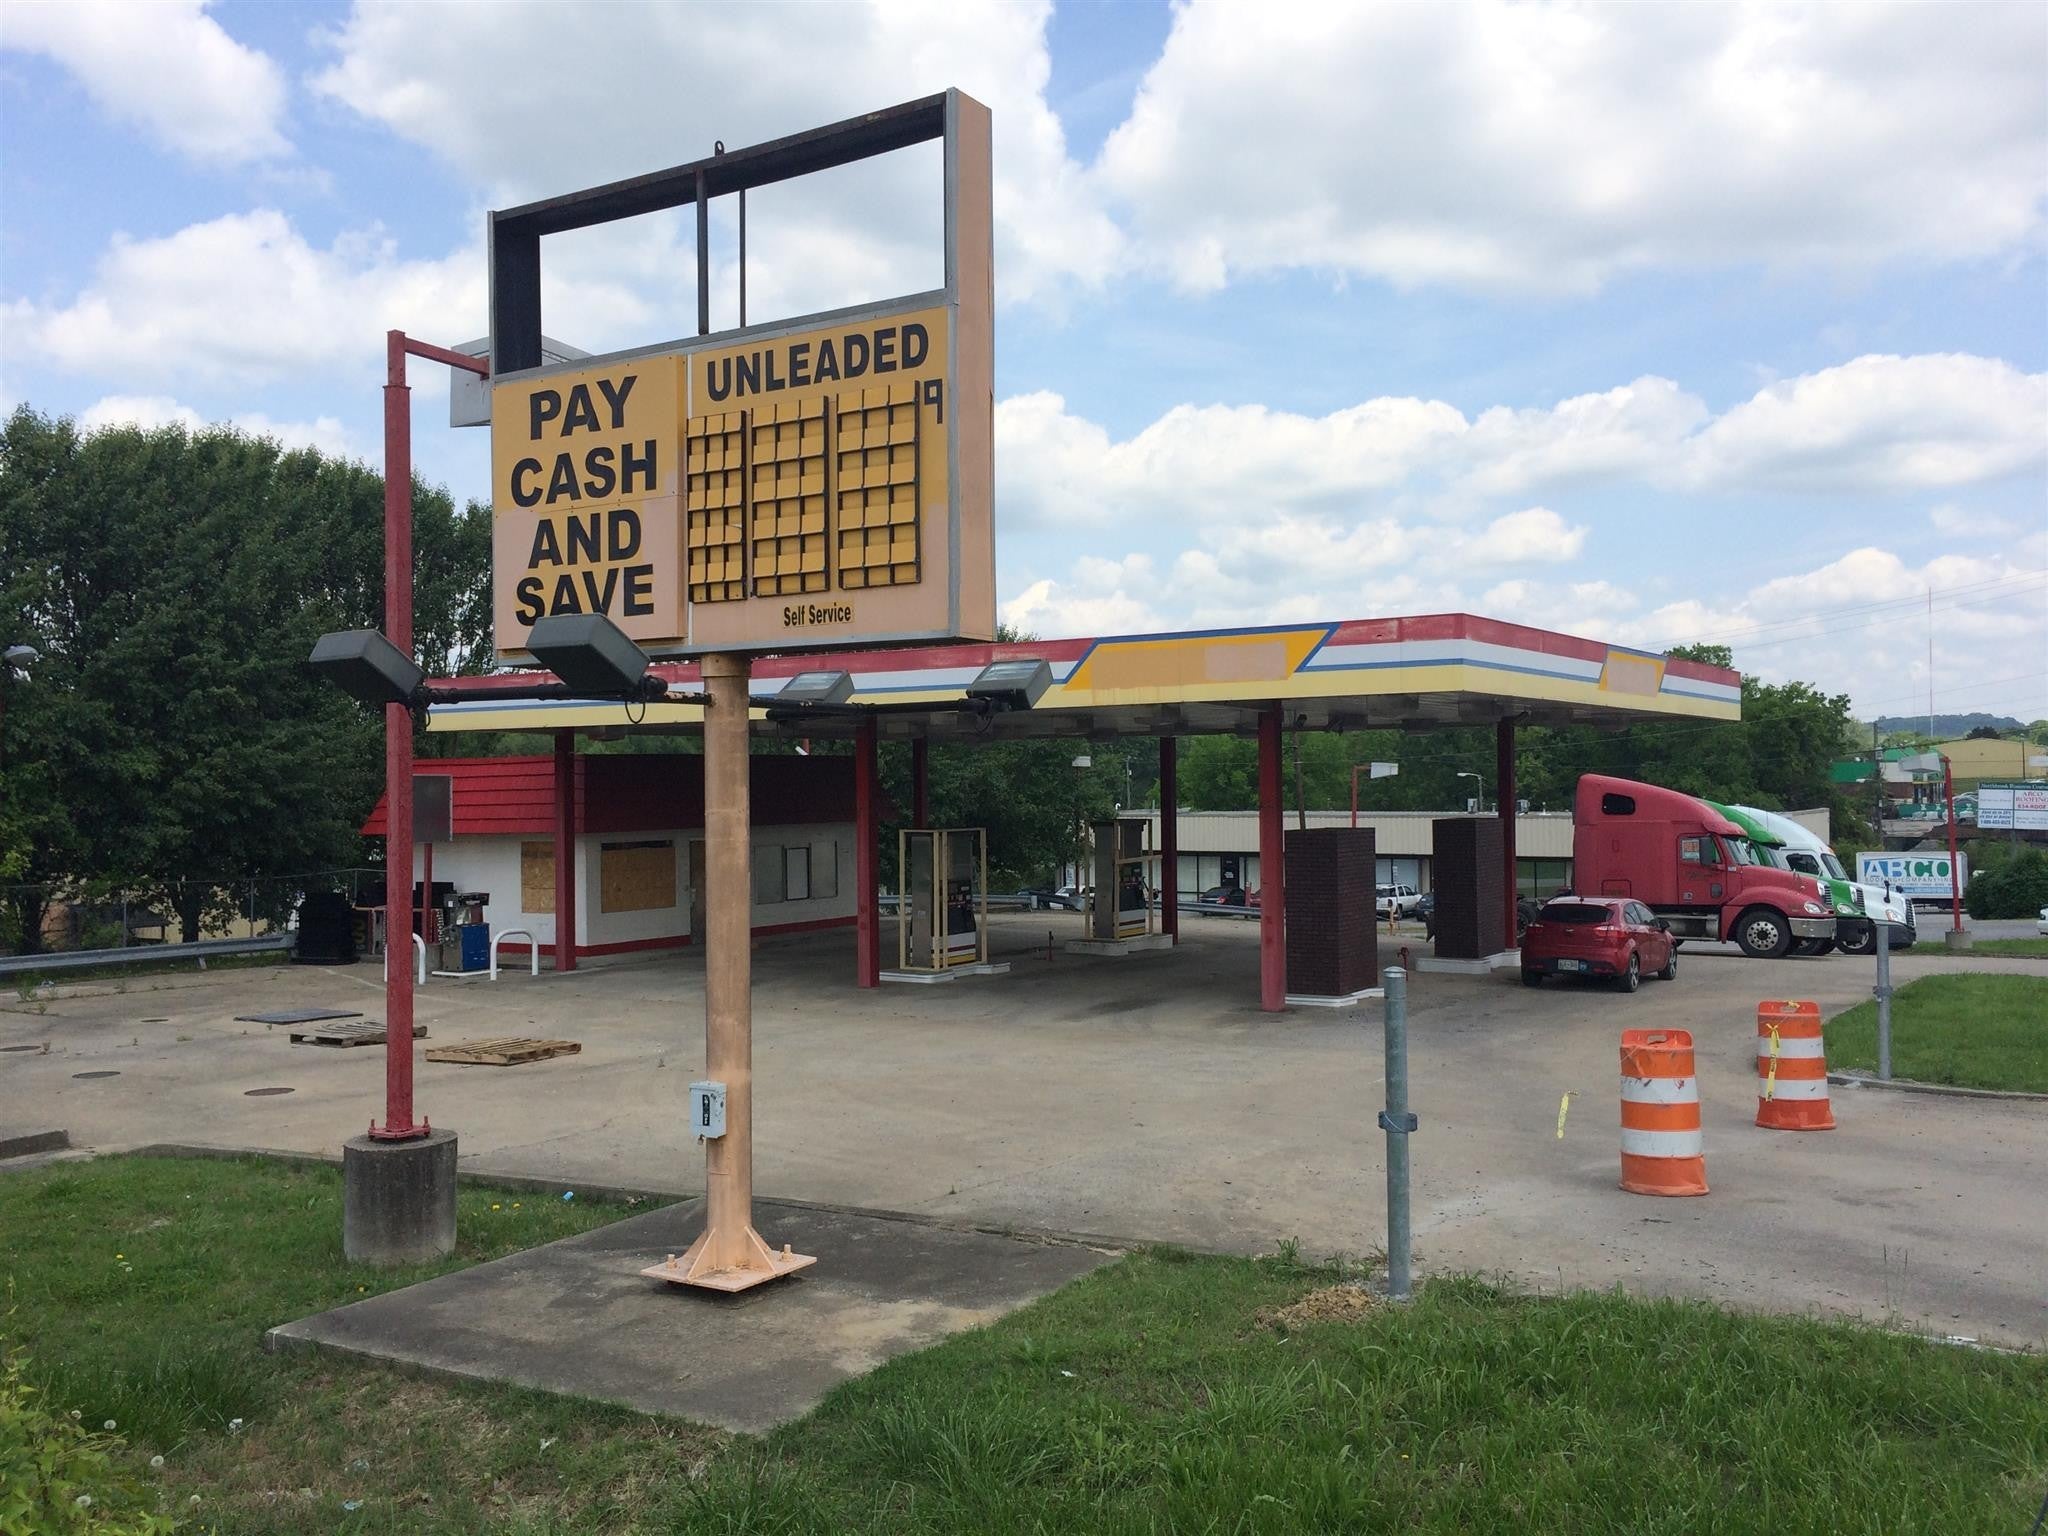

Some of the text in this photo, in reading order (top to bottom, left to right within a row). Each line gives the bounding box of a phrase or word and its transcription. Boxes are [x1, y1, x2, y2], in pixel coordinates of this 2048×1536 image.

[706, 323, 930, 402] UNLEADED
[529, 375, 638, 441] PAY
[510, 439, 658, 508] CASH
[527, 509, 642, 570] AND
[515, 564, 655, 627] SAVE
[783, 602, 852, 627] Self Service
[1864, 860, 1952, 877] ABCO
